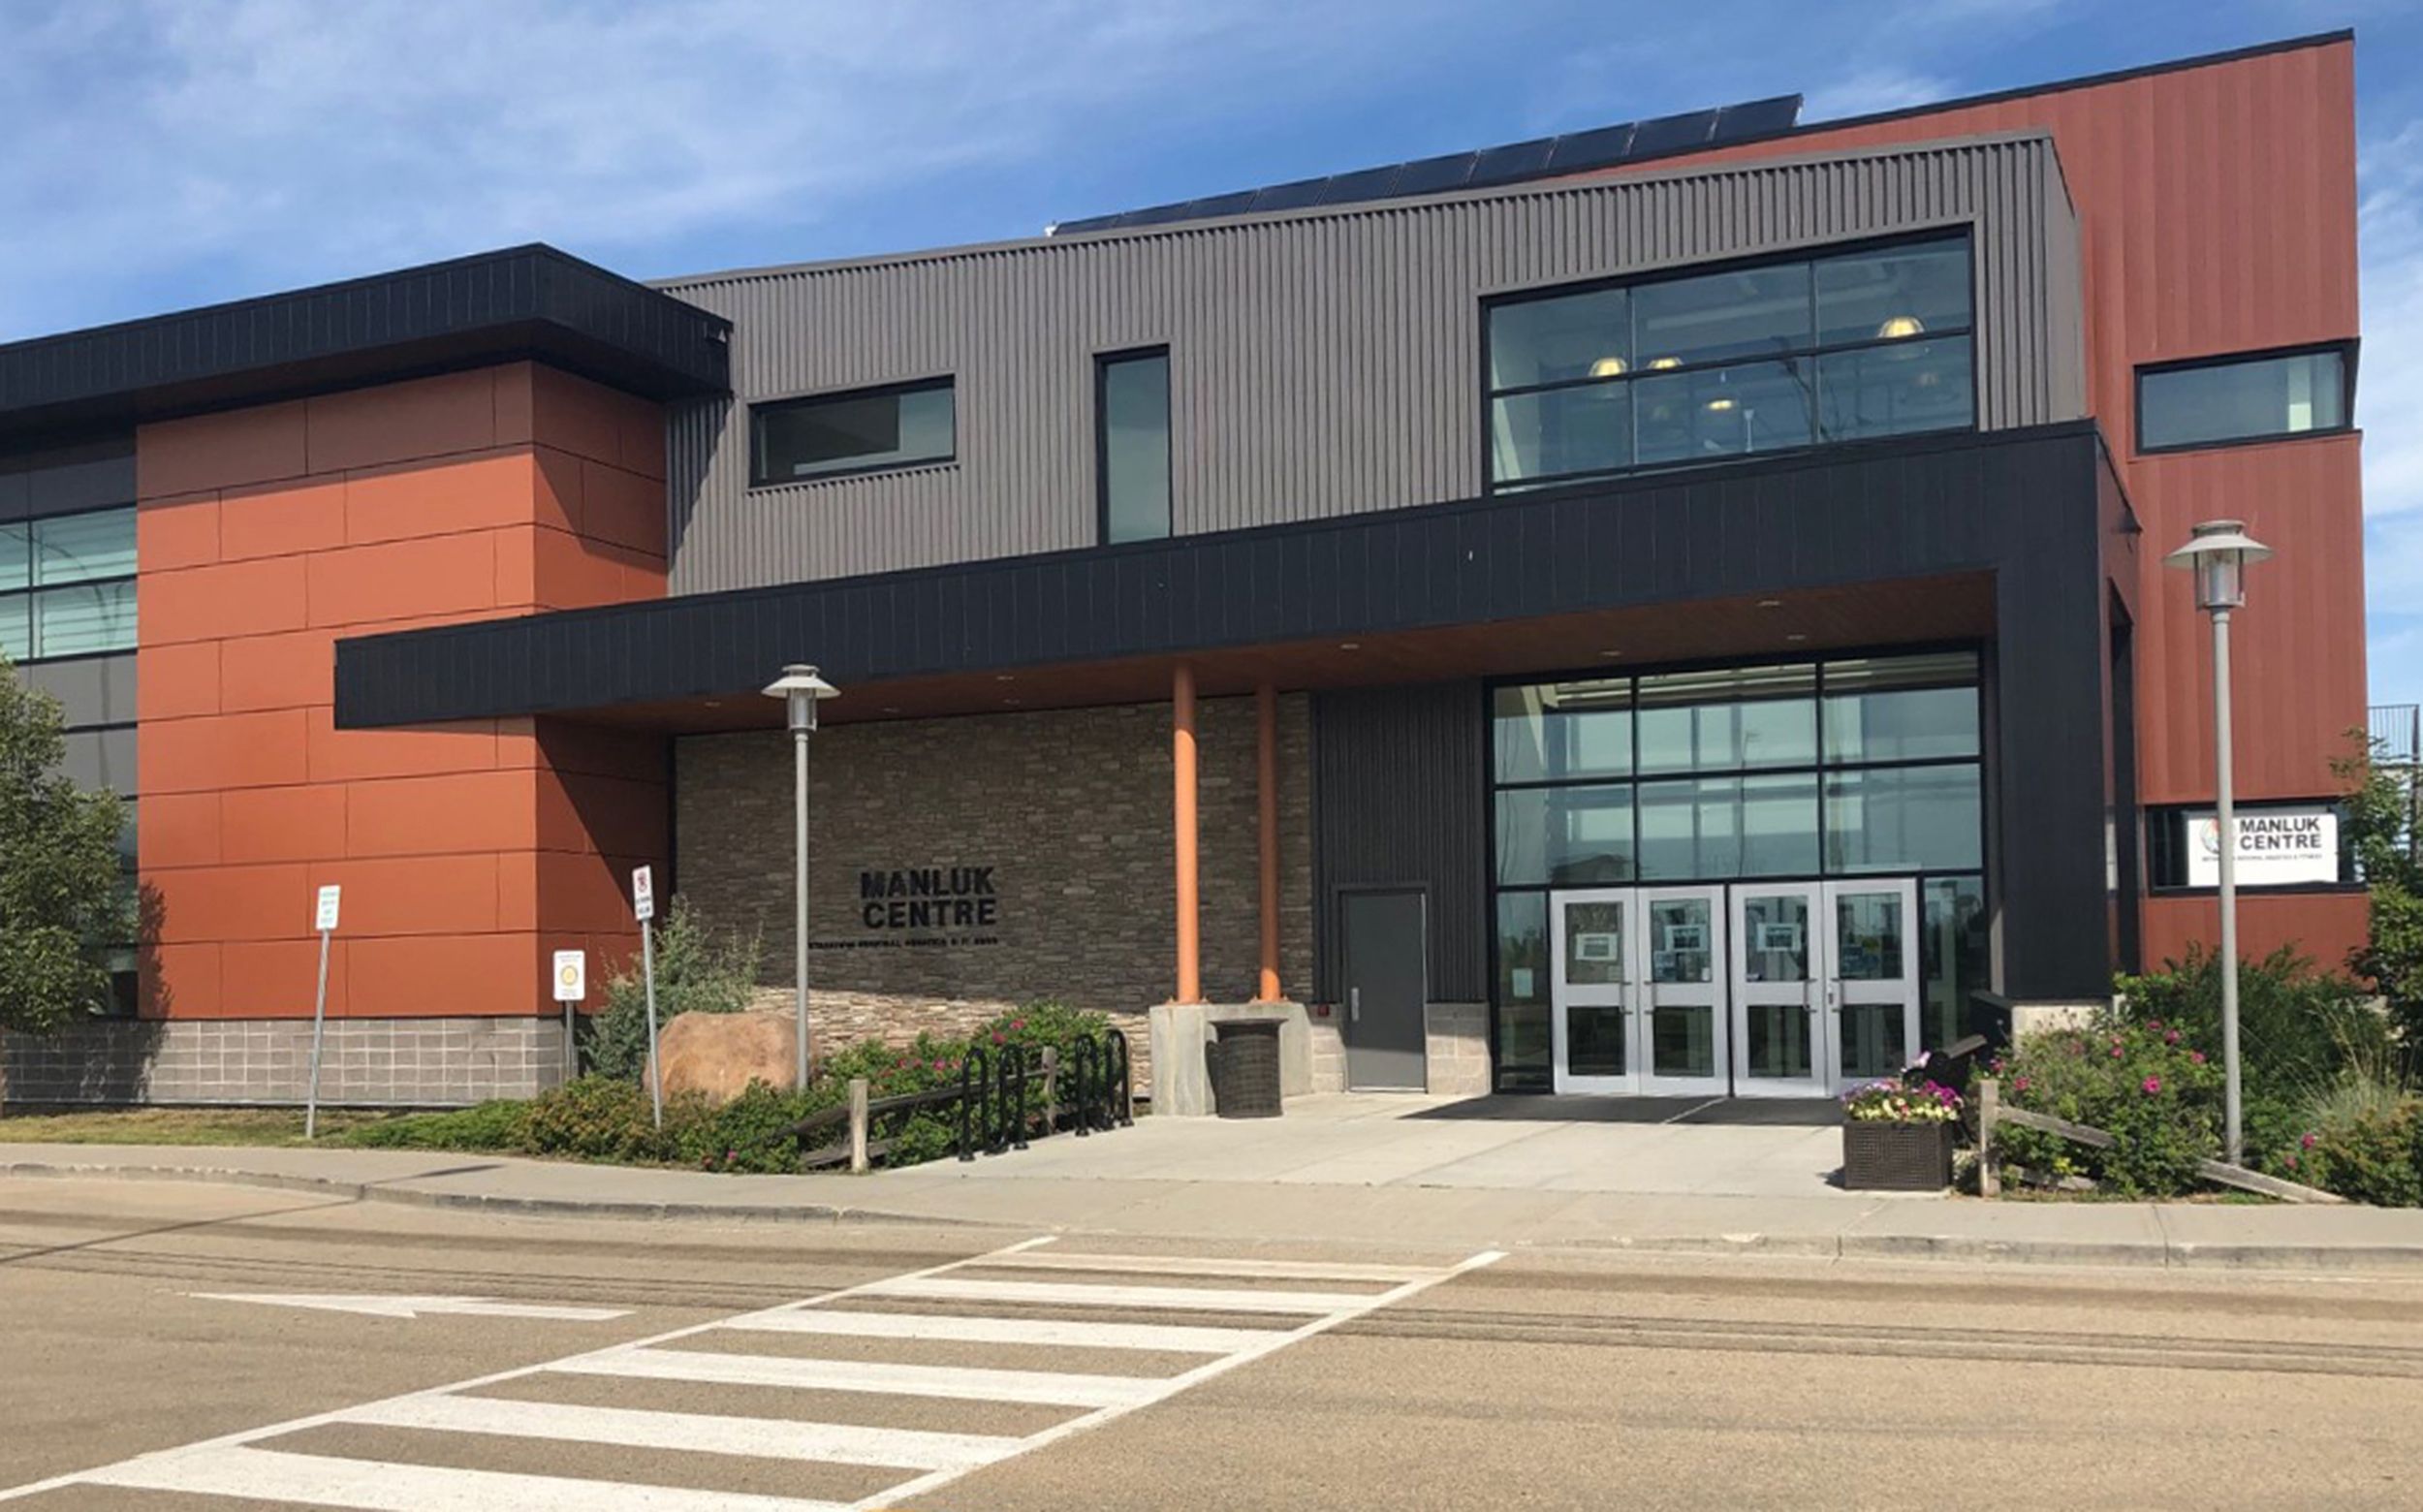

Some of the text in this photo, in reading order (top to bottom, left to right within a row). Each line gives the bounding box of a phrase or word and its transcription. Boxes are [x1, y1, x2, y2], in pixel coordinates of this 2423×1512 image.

[2240, 817, 2320, 834] MANLUK
[2240, 834, 2321, 851] CENTRE
[861, 866, 996, 898] MANLUK
[863, 898, 997, 929] CENTRE
